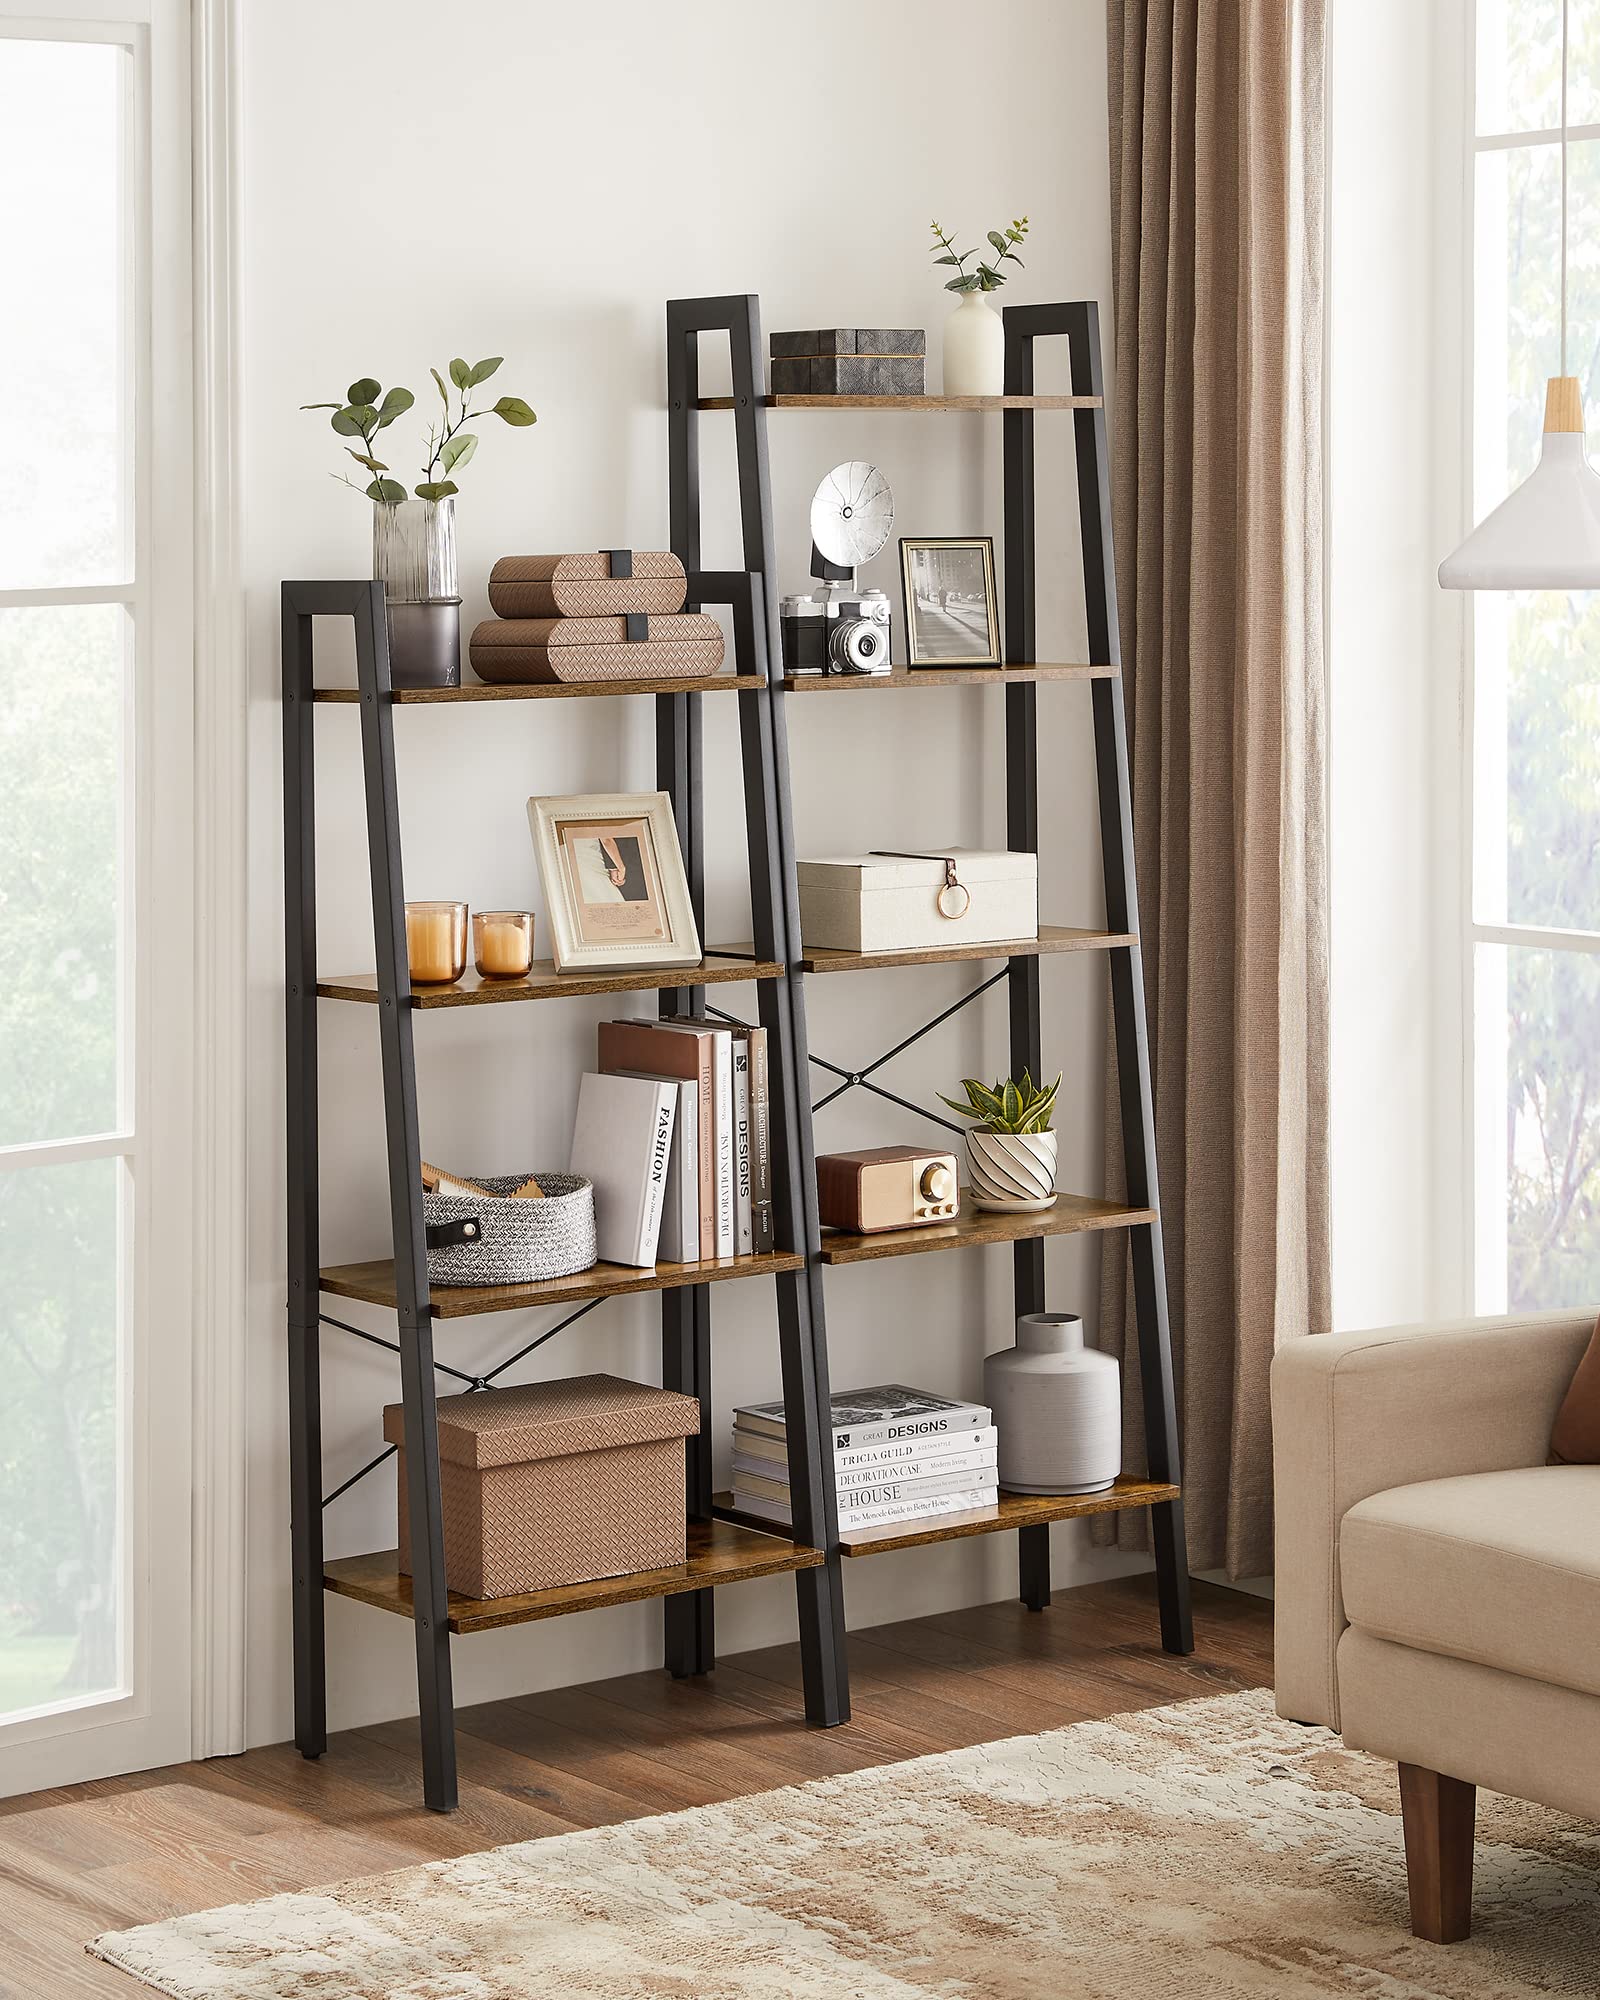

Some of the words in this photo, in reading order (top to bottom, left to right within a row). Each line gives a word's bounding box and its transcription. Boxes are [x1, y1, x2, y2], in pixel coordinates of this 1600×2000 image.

[702, 1065, 711, 1105] HOME
[757, 1087, 765, 1102] ART
[652, 1107, 670, 1183] FASHION
[721, 1131, 729, 1160] CASE
[758, 1109, 767, 1165] ARCHITECTURE
[738, 1120, 750, 1198] DESIGNS
[721, 1162, 729, 1237] DECORATION
[863, 1432, 883, 1441] GREAT
[888, 1420, 948, 1439] DESIGNS
[841, 1453, 878, 1466] TRICIA
[881, 1447, 913, 1459] GUILD
[840, 1467, 899, 1486] DECORATION
[900, 1463, 923, 1477] CASE
[930, 1461, 952, 1469] Modern
[849, 1485, 902, 1507] HOUSE
[849, 1514, 861, 1522] The
[862, 1509, 887, 1520] Monocle
[888, 1505, 906, 1515] Guide
[913, 1502, 931, 1511] Better
[931, 1499, 951, 1507] House
